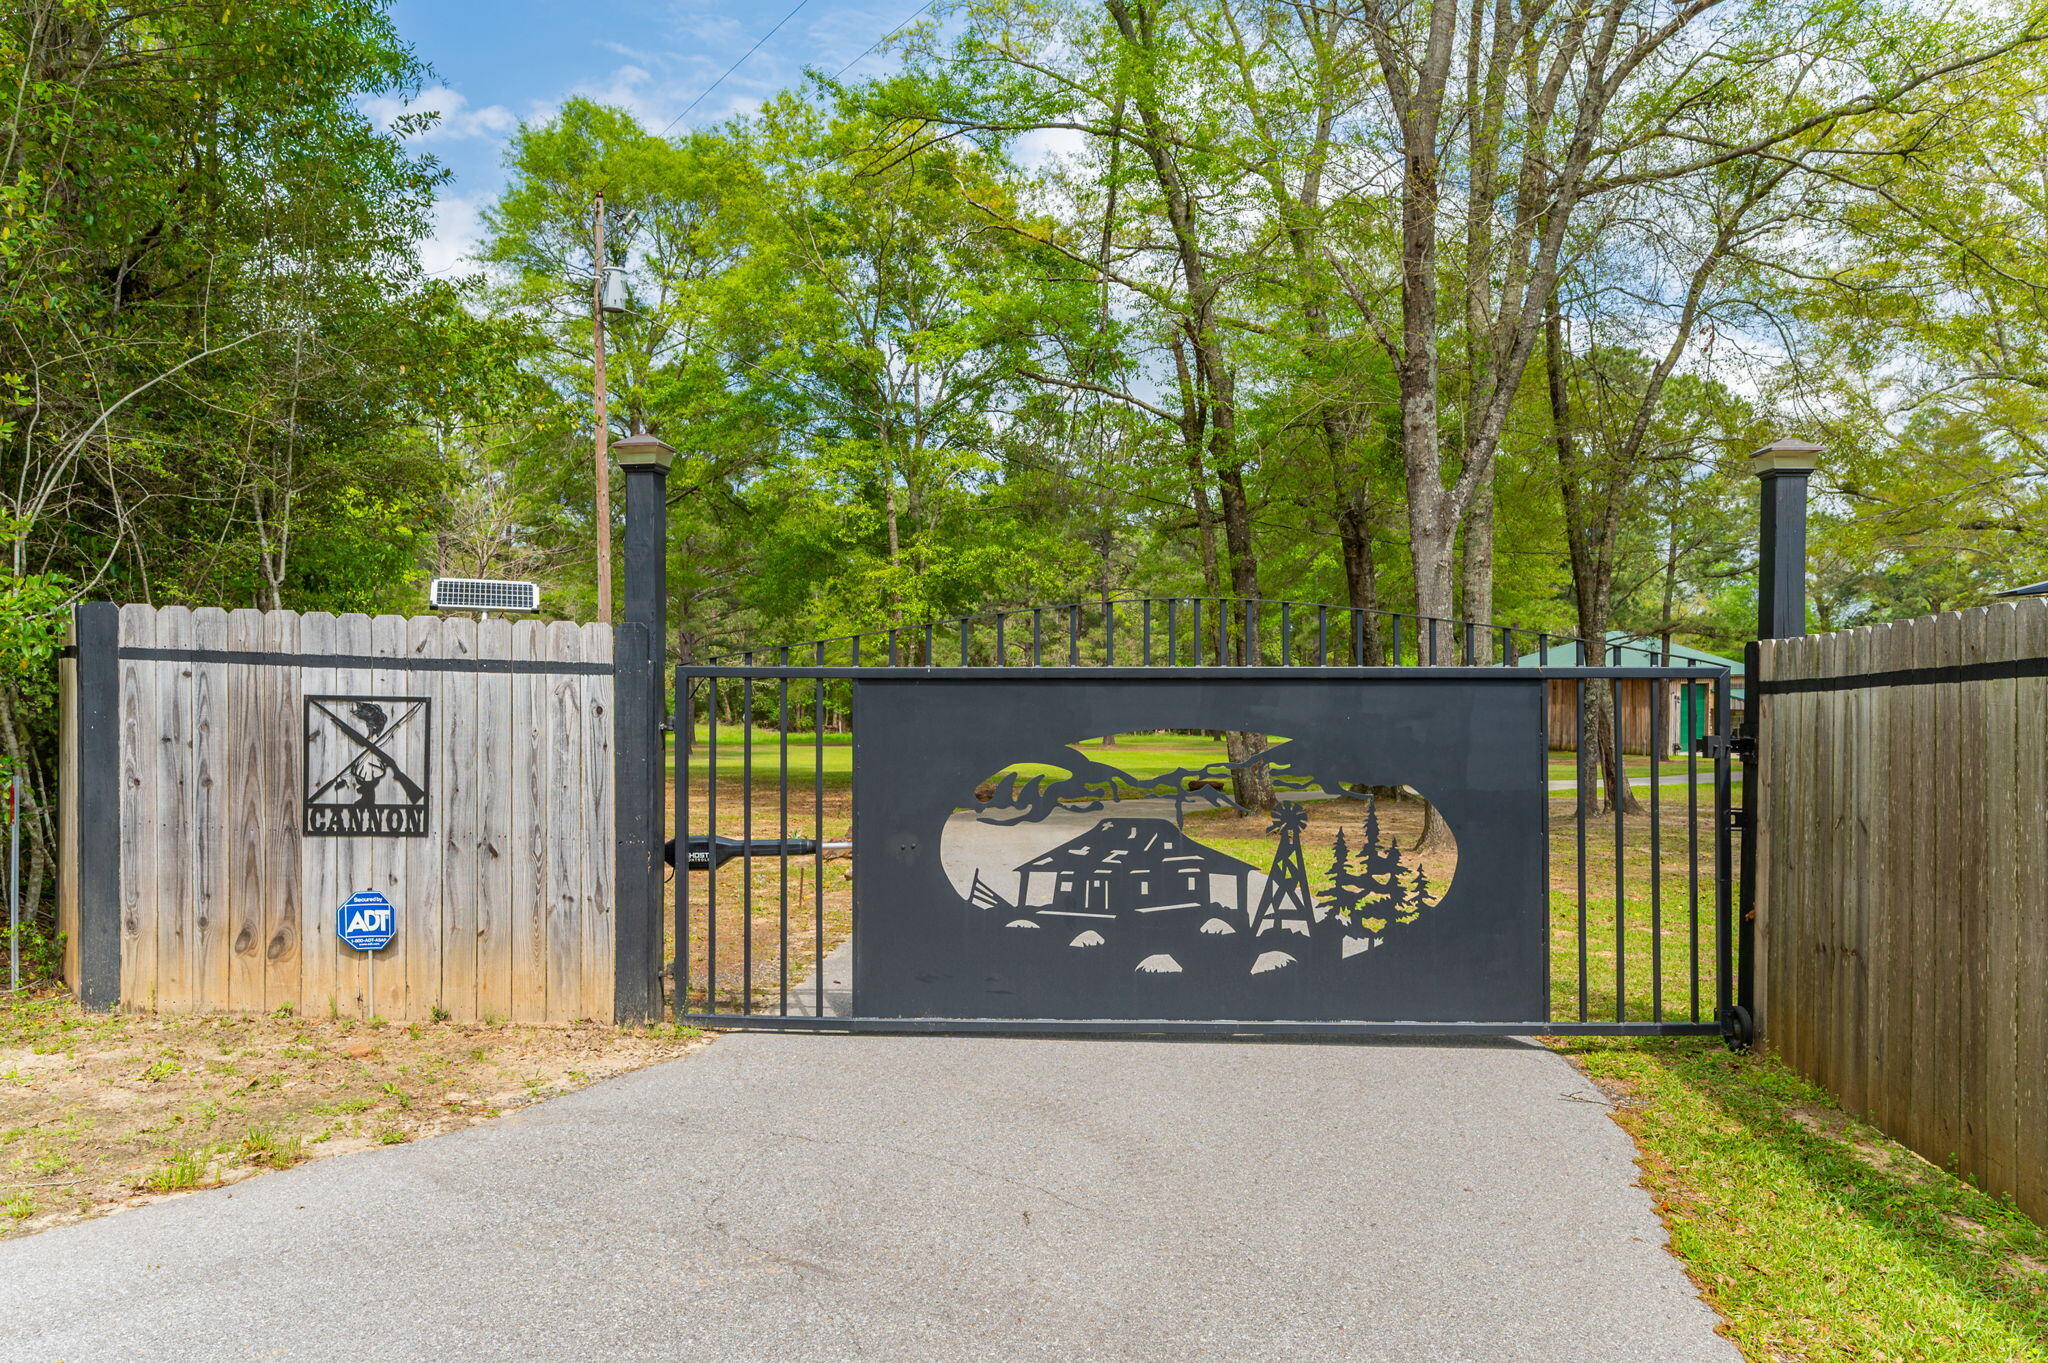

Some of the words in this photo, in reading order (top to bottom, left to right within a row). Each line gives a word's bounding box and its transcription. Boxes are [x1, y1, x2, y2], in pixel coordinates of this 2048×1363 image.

[309, 807, 423, 832] CANNON
[688, 852, 710, 861] HOST
[347, 910, 390, 933] ADT
